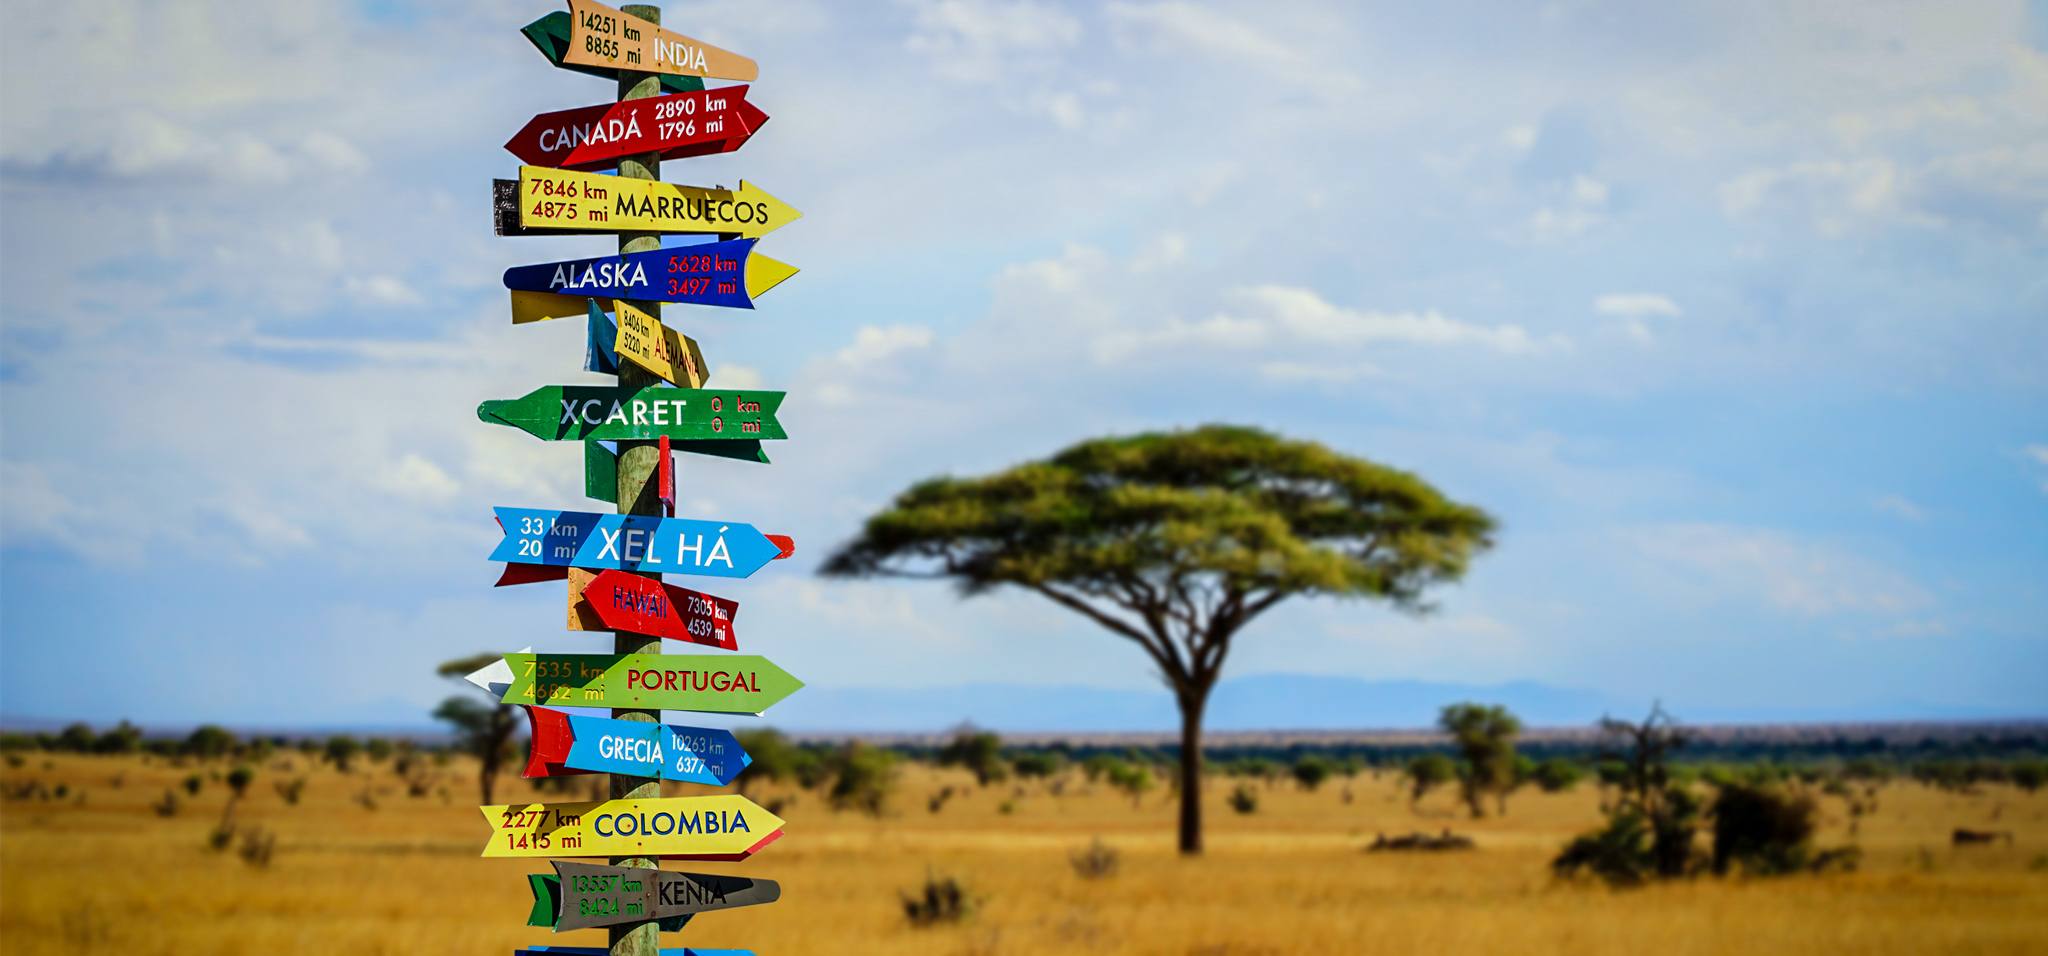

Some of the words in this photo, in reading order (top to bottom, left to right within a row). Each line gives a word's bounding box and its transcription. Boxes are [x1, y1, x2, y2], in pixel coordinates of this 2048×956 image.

[579, 10, 617, 35] 14251
[624, 20, 641, 42] km
[586, 35, 619, 59] 8855
[627, 47, 641, 64] mi
[654, 37, 708, 72] INDIA
[655, 98, 695, 120] 2890
[705, 94, 727, 112] km
[539, 109, 642, 152] CANADÁ
[658, 119, 695, 141] 1796
[706, 115, 723, 134] mi
[530, 179, 577, 198] 7846
[583, 180, 607, 200] km
[531, 201, 577, 221] 4875
[589, 206, 608, 222] mi
[615, 193, 768, 225] MARRUECOS
[549, 261, 648, 289] ALASKA
[667, 253, 710, 273] 5628
[715, 253, 737, 271] km
[667, 278, 710, 295] 3497
[718, 276, 736, 294] mi
[624, 310, 640, 333] 8406
[640, 317, 650, 338] km
[624, 332, 641, 354] 5220
[642, 344, 650, 360] mi
[654, 336, 700, 379] ALEMANIA
[560, 399, 687, 426] XCARET
[711, 397, 723, 413] 0
[737, 396, 760, 413] km
[711, 417, 723, 433] 0
[742, 418, 761, 433] mi
[520, 517, 544, 535] 33
[550, 517, 577, 537] km
[518, 539, 542, 557] 20
[554, 540, 577, 559] mi
[597, 527, 662, 564] XEL
[677, 525, 734, 568] HÁ
[613, 585, 667, 619] HAWAII
[688, 596, 713, 617] 7305
[714, 600, 728, 621] km
[687, 617, 712, 637] 4539
[715, 625, 726, 641] mi
[523, 660, 572, 678] 7535
[580, 661, 605, 679] km
[627, 669, 761, 693] PORTUGAL
[523, 681, 571, 700] 4682
[584, 685, 605, 700] mi
[599, 734, 664, 764] GRECIA
[671, 733, 706, 754] 10263
[709, 736, 724, 756] km
[676, 757, 705, 775] 6377
[711, 759, 724, 776] mi
[502, 810, 551, 829] 2277
[555, 810, 581, 828] km
[594, 809, 750, 838] COLOMBIA
[507, 832, 550, 851] 1415
[562, 832, 582, 849] mi
[571, 875, 618, 894] 13557
[621, 875, 643, 893] km
[659, 880, 727, 906] KENIA
[579, 899, 619, 917] 8424
[626, 899, 643, 916] mi
